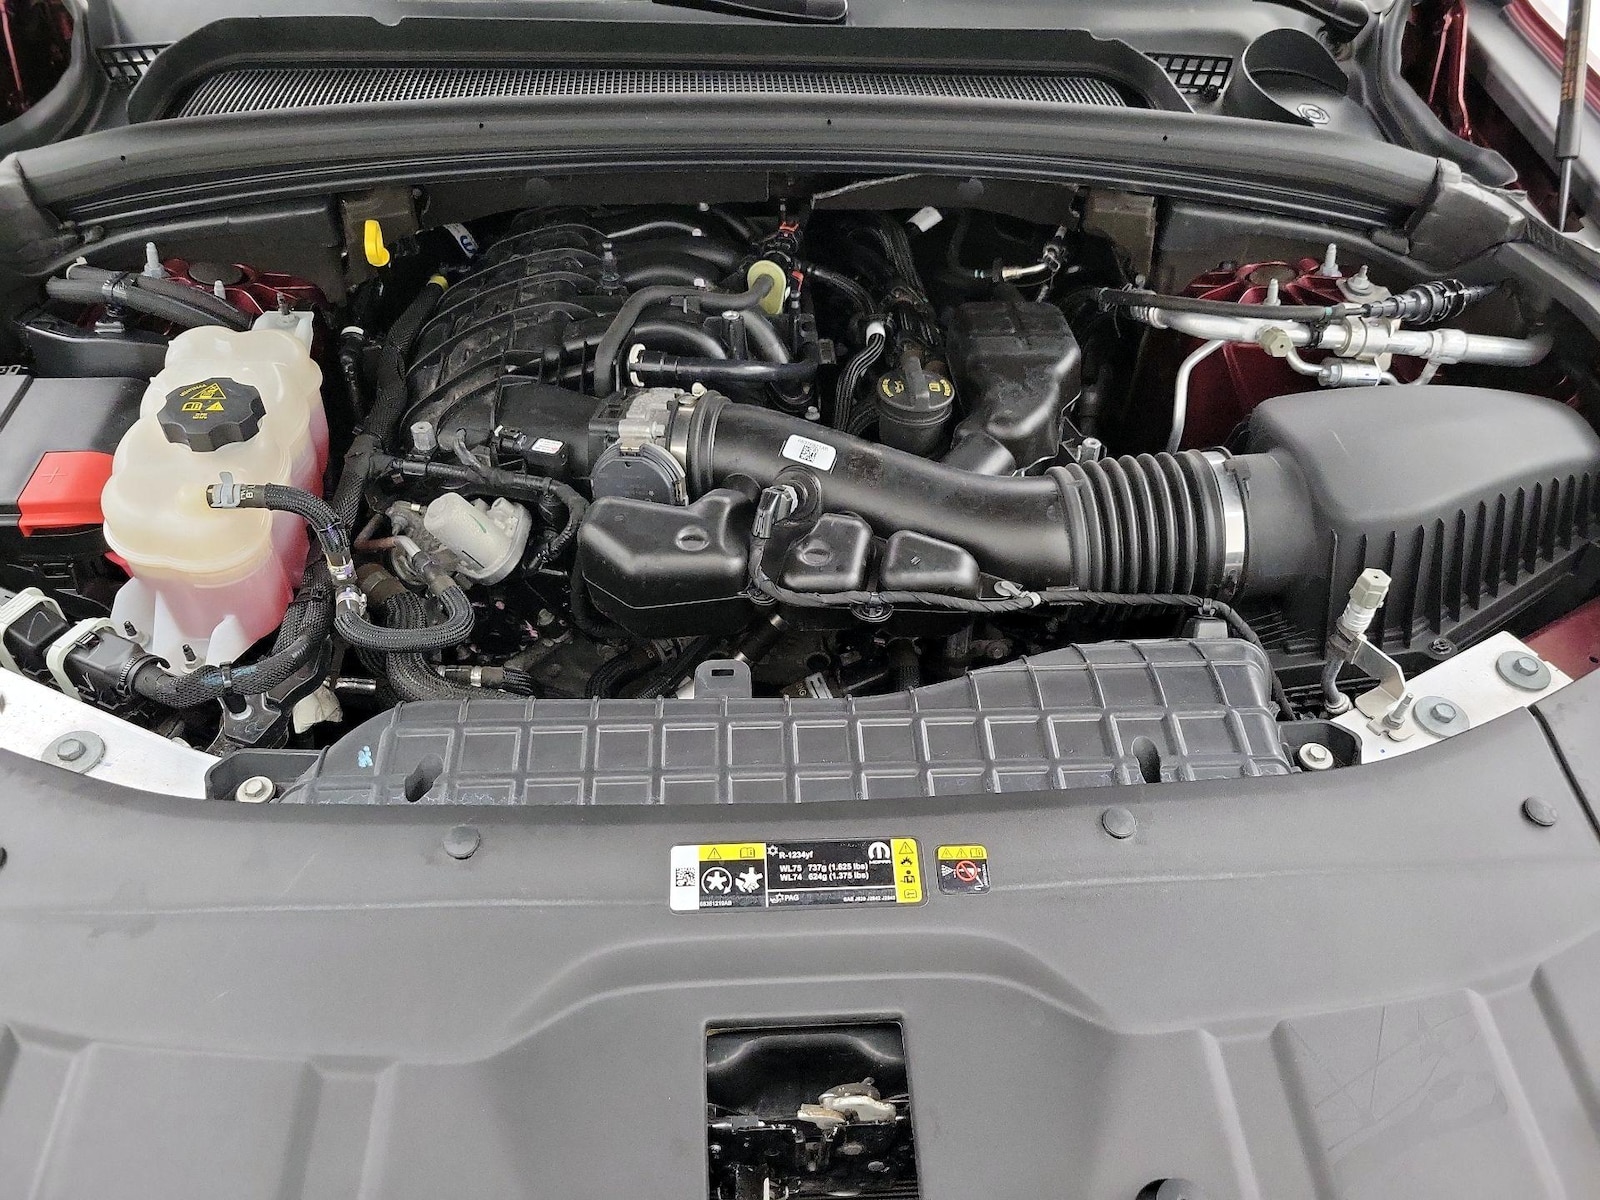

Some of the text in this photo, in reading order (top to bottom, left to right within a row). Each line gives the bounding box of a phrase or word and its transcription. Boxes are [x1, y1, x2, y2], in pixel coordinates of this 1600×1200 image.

[779, 851, 814, 860] R-1234yf
[780, 862, 869, 873] WL75 737g (1.625 lbs)
[780, 871, 870, 882] WL74 624g (1.375 lbs)
